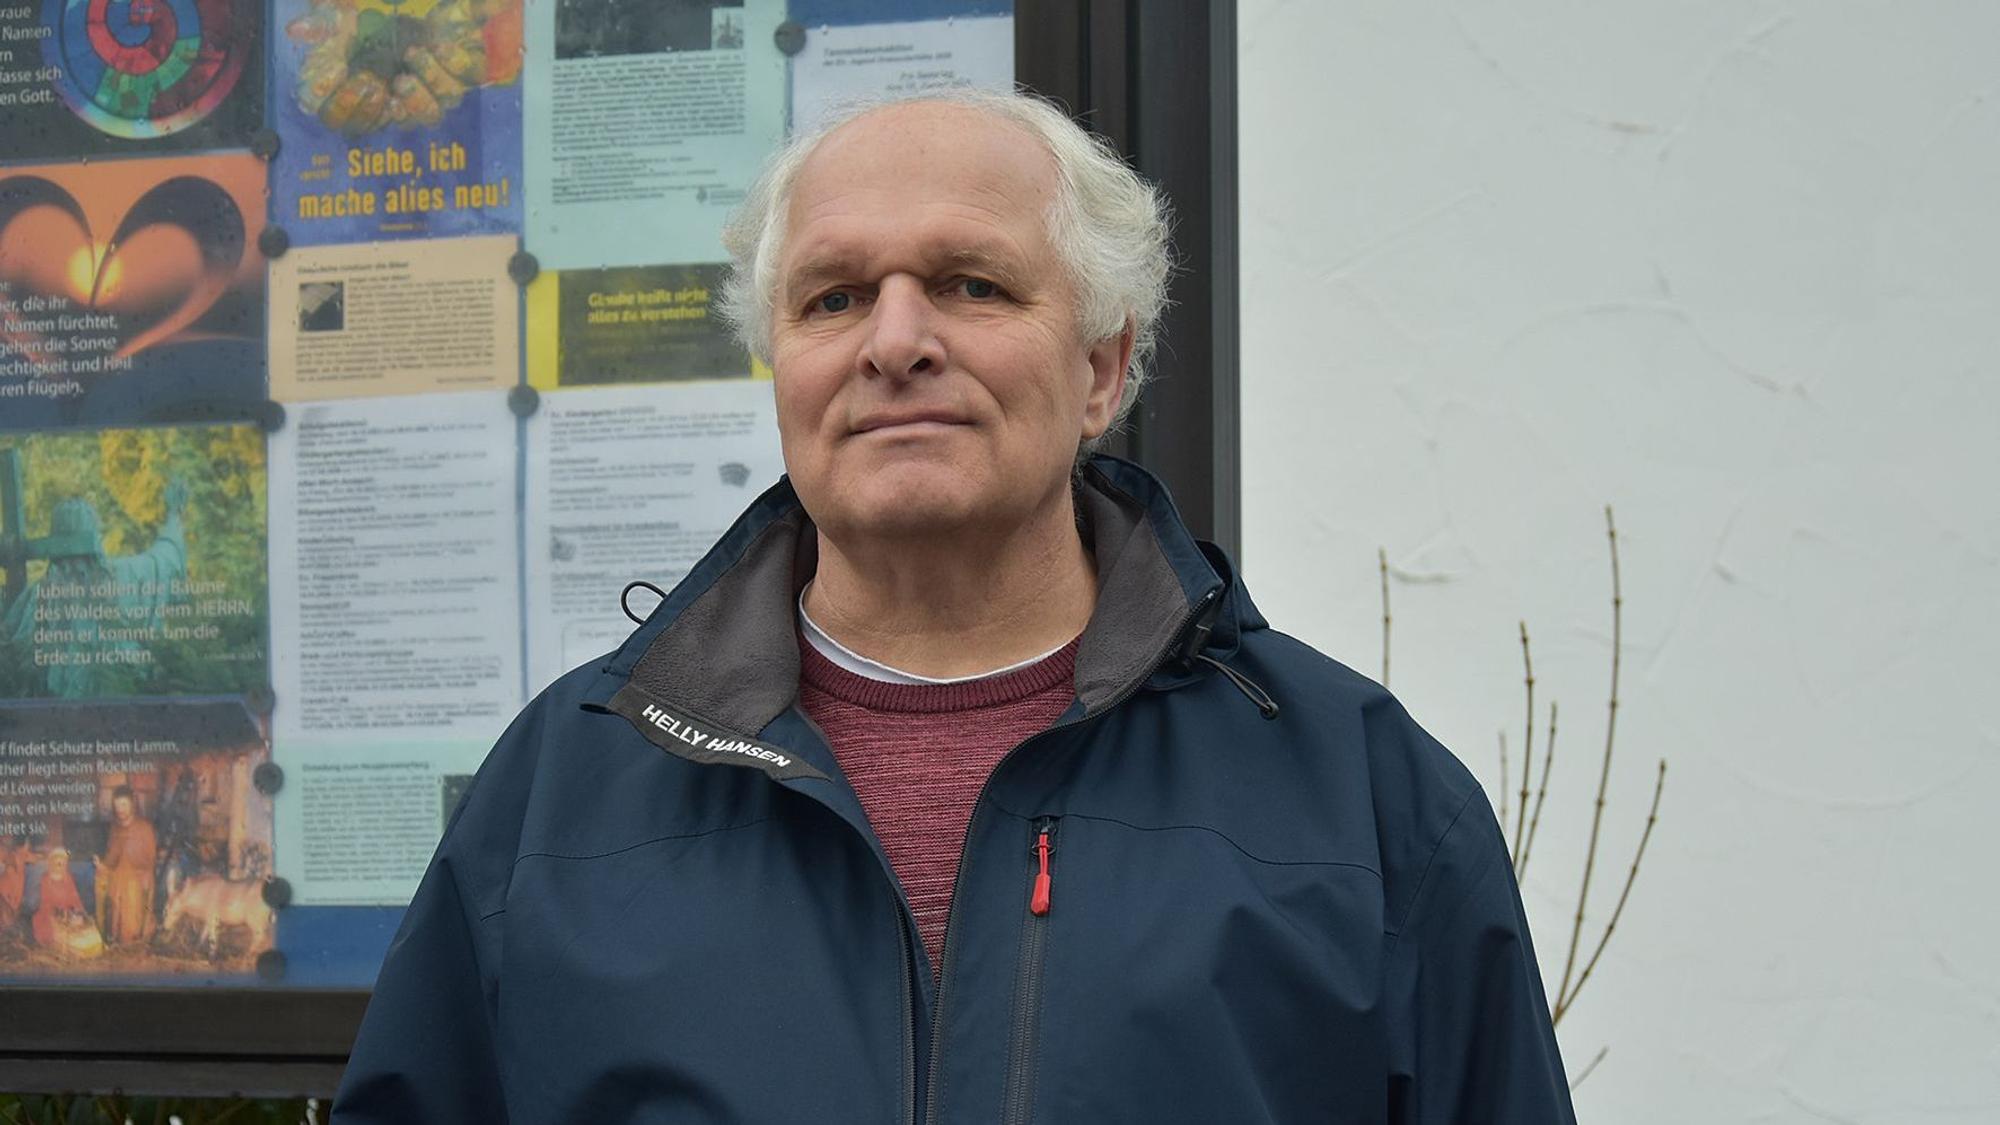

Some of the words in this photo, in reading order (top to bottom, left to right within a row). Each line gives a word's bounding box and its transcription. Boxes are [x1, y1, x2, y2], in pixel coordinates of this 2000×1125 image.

[2, 25, 52, 41] Namen
[35, 65, 62, 82] sich
[20, 88, 55, 105] Gott.
[348, 146, 423, 179] Siehe,
[430, 141, 466, 171] ich
[299, 189, 376, 218] mache
[455, 178, 509, 208] neu!
[22, 296, 46, 312] die
[49, 295, 67, 310] ihr
[4, 318, 55, 333] Namen
[44, 336, 67, 351] die
[70, 335, 117, 350] Sonne
[72, 357, 100, 372] und
[34, 582, 86, 600] Jubeln
[90, 580, 137, 597] sollen
[141, 579, 165, 596] die
[170, 578, 226, 595] Bäume
[34, 605, 61, 621] des
[64, 603, 121, 620] Waldes
[125, 605, 151, 619] vor
[155, 601, 191, 617] dem
[34, 628, 74, 644] denn
[78, 630, 93, 642] er
[193, 624, 220, 639] die
[34, 649, 69, 666] Erde
[73, 652, 91, 664] zu
[642, 704, 708, 746] HELLY
[705, 737, 791, 767] HANSEN
[8, 742, 47, 756] findet
[49, 741, 93, 755] Schutz
[96, 740, 130, 754] beim
[28, 761, 57, 778] liegt
[60, 760, 93, 774] beim
[11, 780, 46, 796] Löwe
[48, 779, 96, 795] weiden
[27, 800, 47, 814] ein
